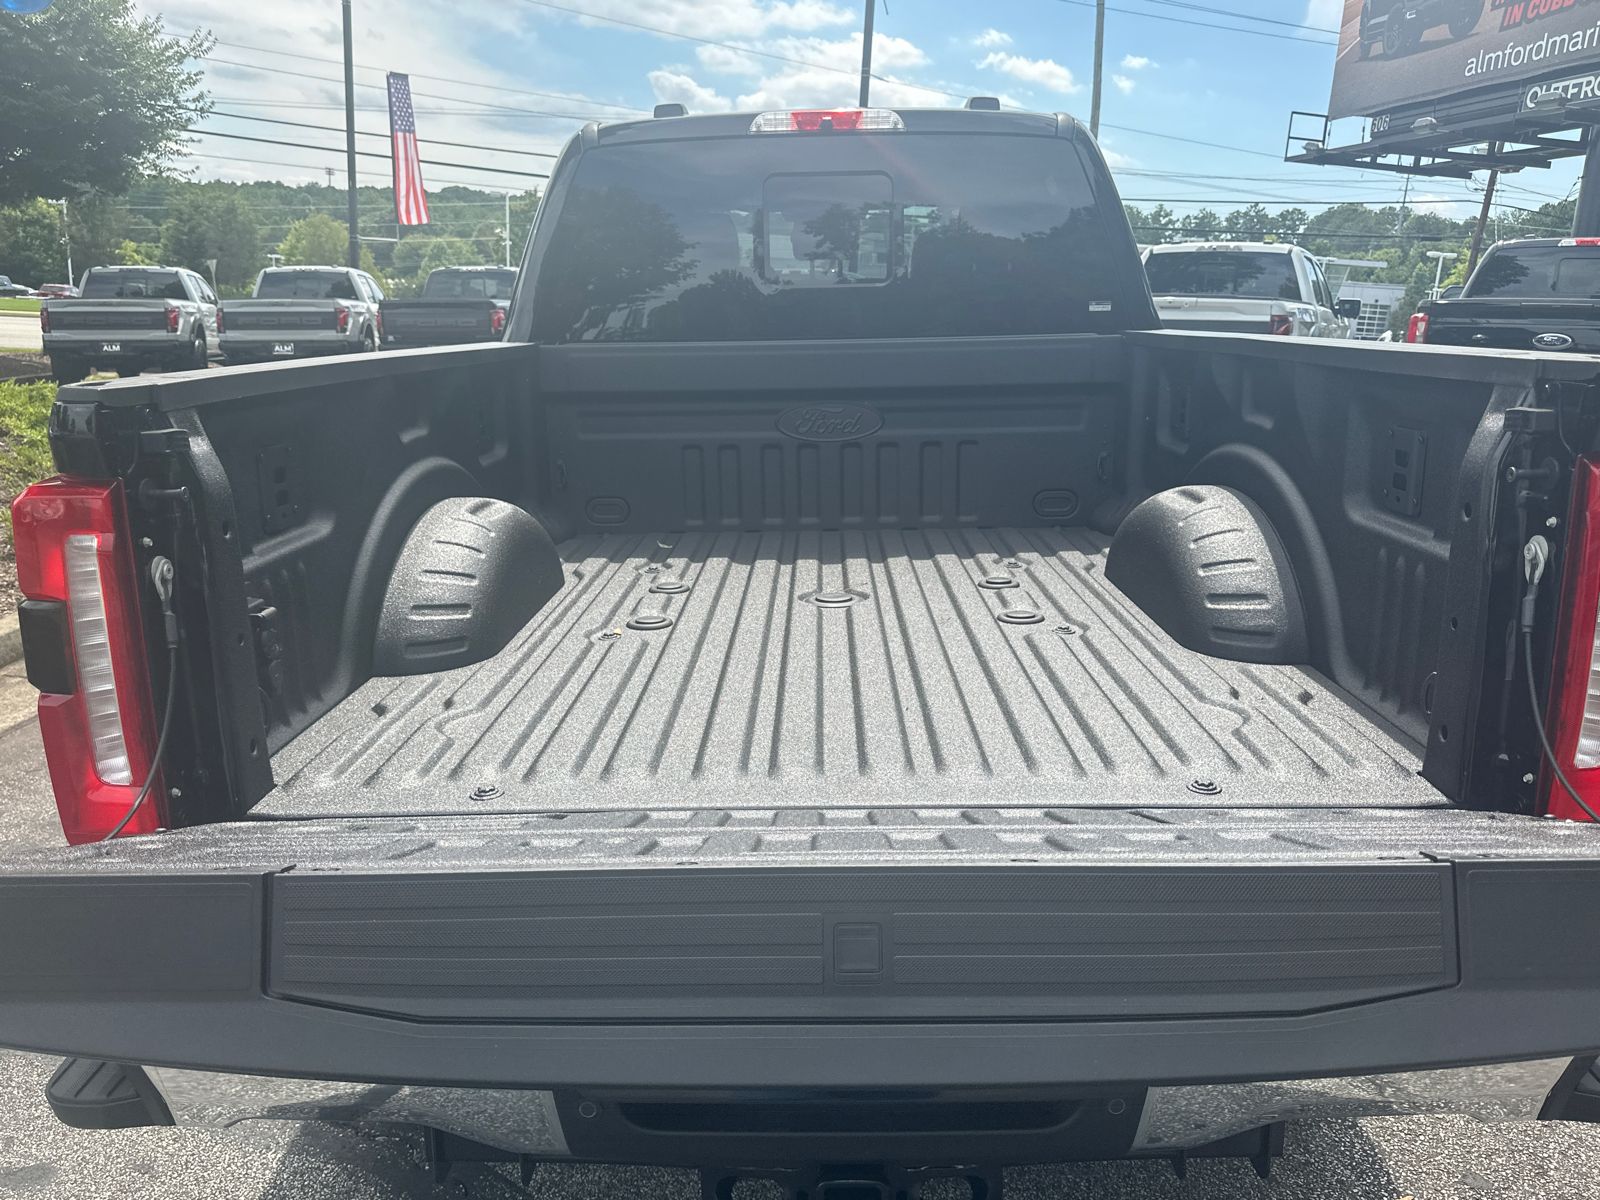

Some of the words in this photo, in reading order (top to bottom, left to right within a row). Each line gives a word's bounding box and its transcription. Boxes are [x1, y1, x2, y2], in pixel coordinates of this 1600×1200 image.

[1502, 3, 1525, 27] IN
[102, 343, 121, 352] ALM
[273, 344, 293, 353] ALM
[795, 406, 865, 434] Ford
